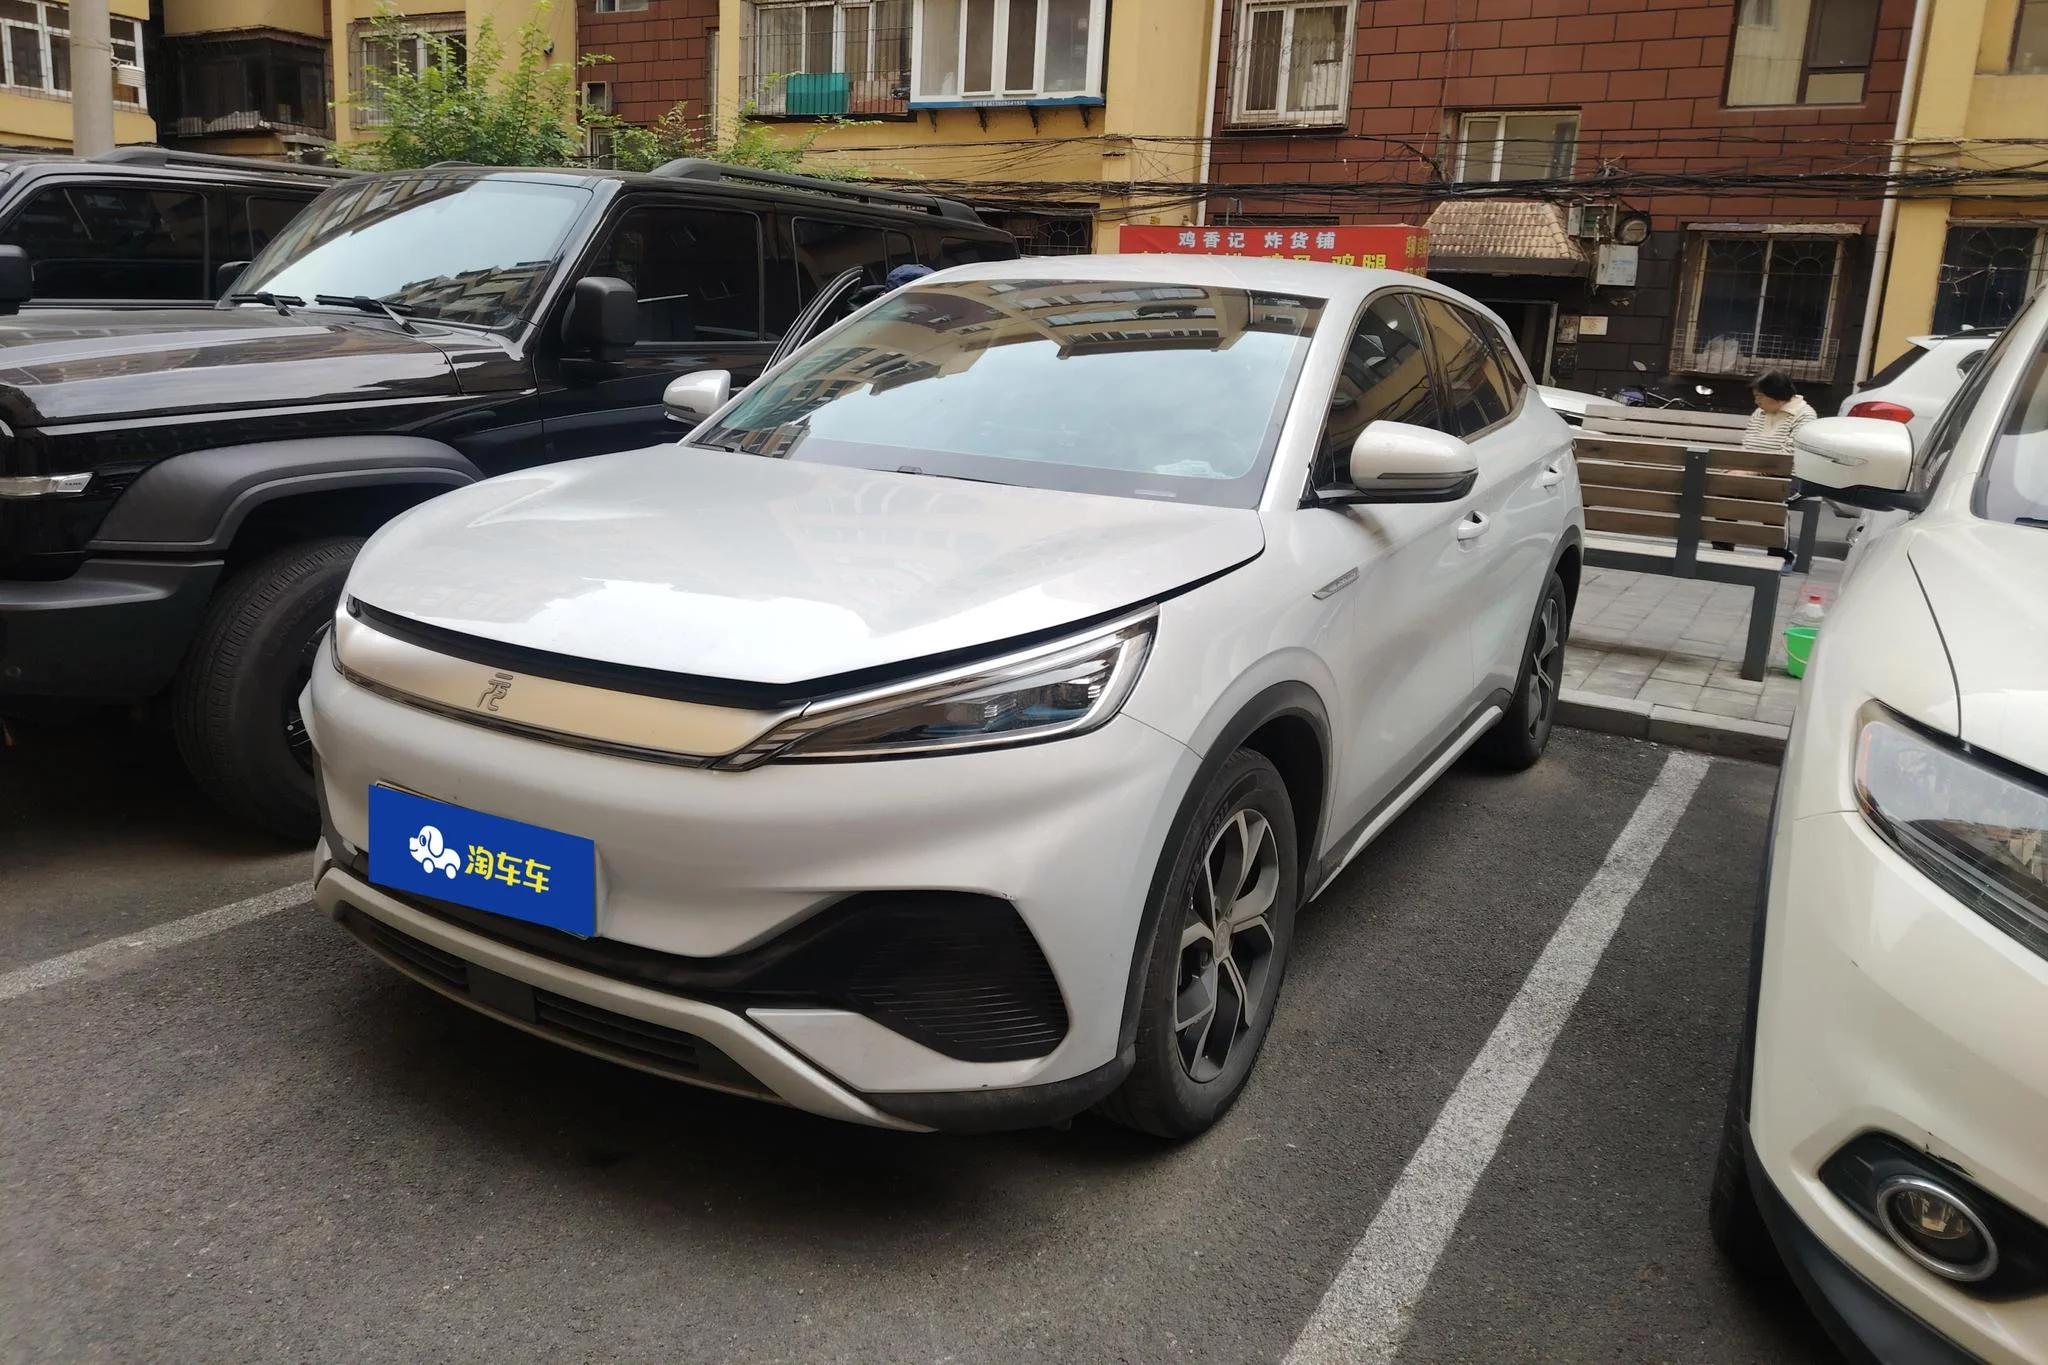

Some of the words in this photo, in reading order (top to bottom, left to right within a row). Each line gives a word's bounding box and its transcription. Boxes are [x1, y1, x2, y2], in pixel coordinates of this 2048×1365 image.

[1178, 231, 1246, 249] 鸡香记
[1264, 231, 1336, 250] 炸货铺
